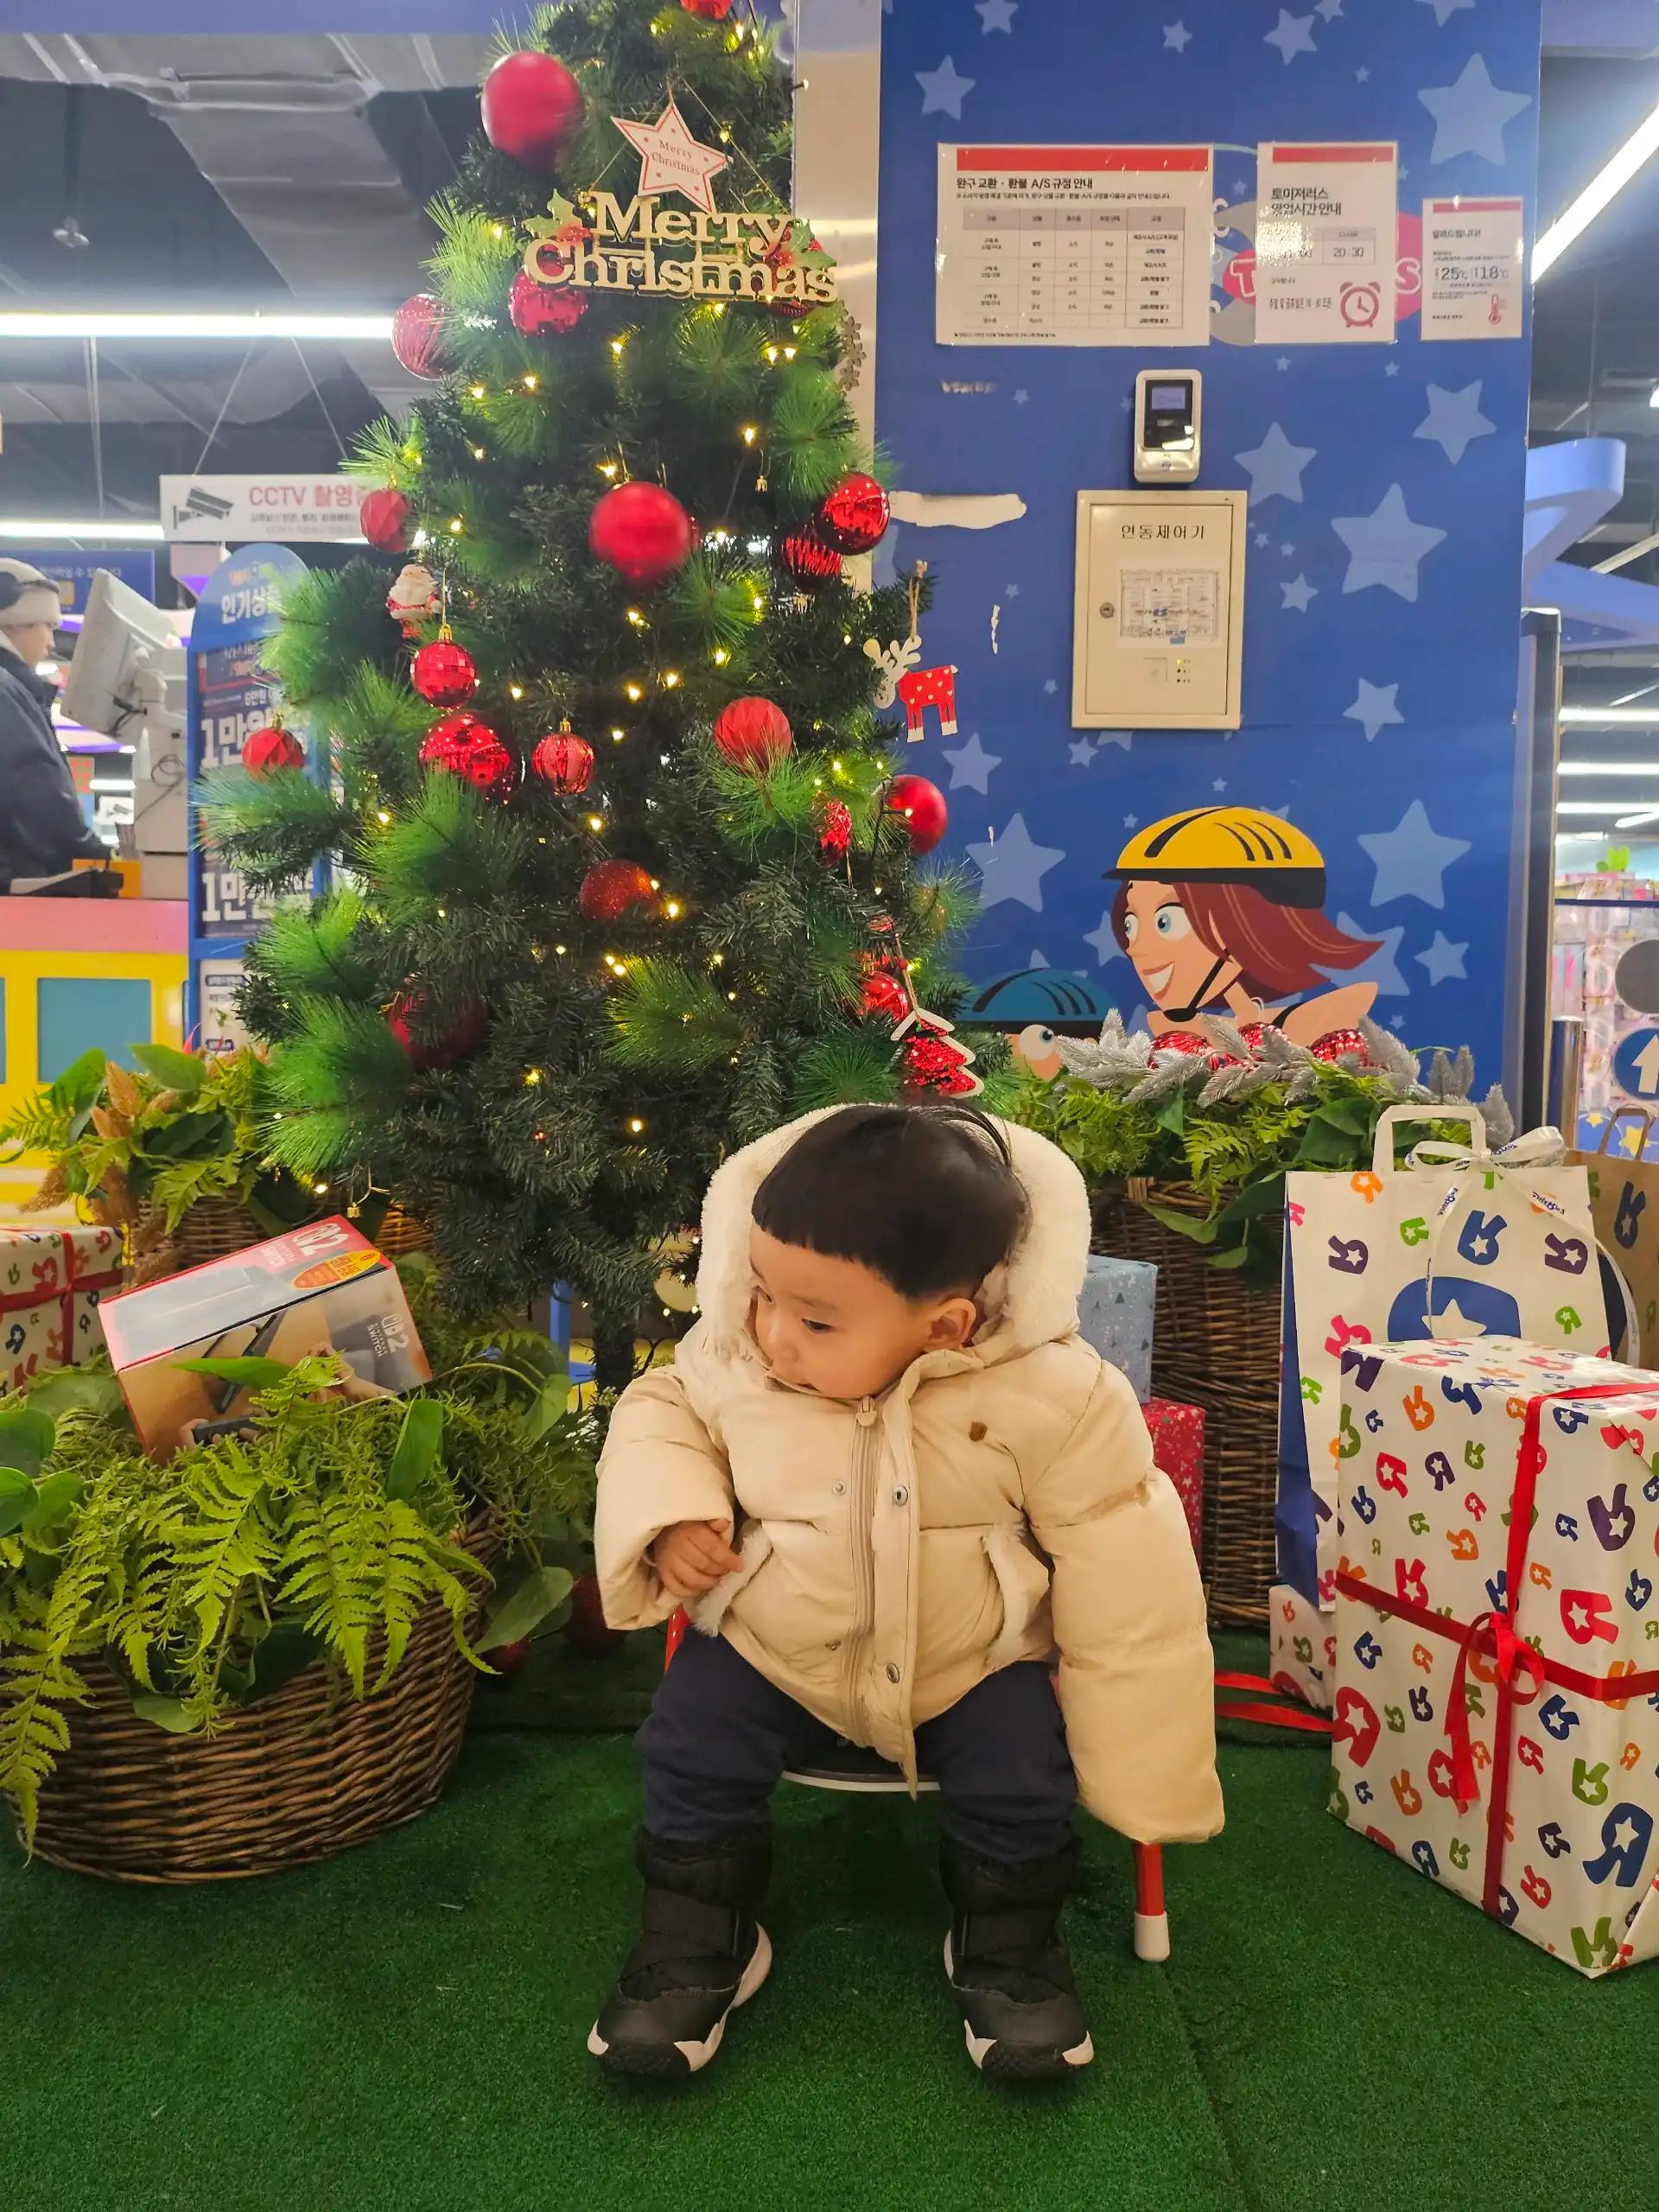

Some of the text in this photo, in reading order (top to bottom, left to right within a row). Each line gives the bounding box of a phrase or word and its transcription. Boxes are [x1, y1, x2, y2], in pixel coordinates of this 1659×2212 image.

[658, 138, 692, 158] Merry
[652, 151, 700, 175] Christmas
[957, 178, 1093, 189] 완구 교환 환불 A/S 규정 안내
[1271, 187, 1328, 200] 토이저러스
[1319, 202, 1342, 215] 안내
[588, 191, 794, 256] Merry
[523, 238, 839, 302] Christmas
[249, 486, 306, 507] CCTV
[1122, 524, 1205, 540] 연동제어기
